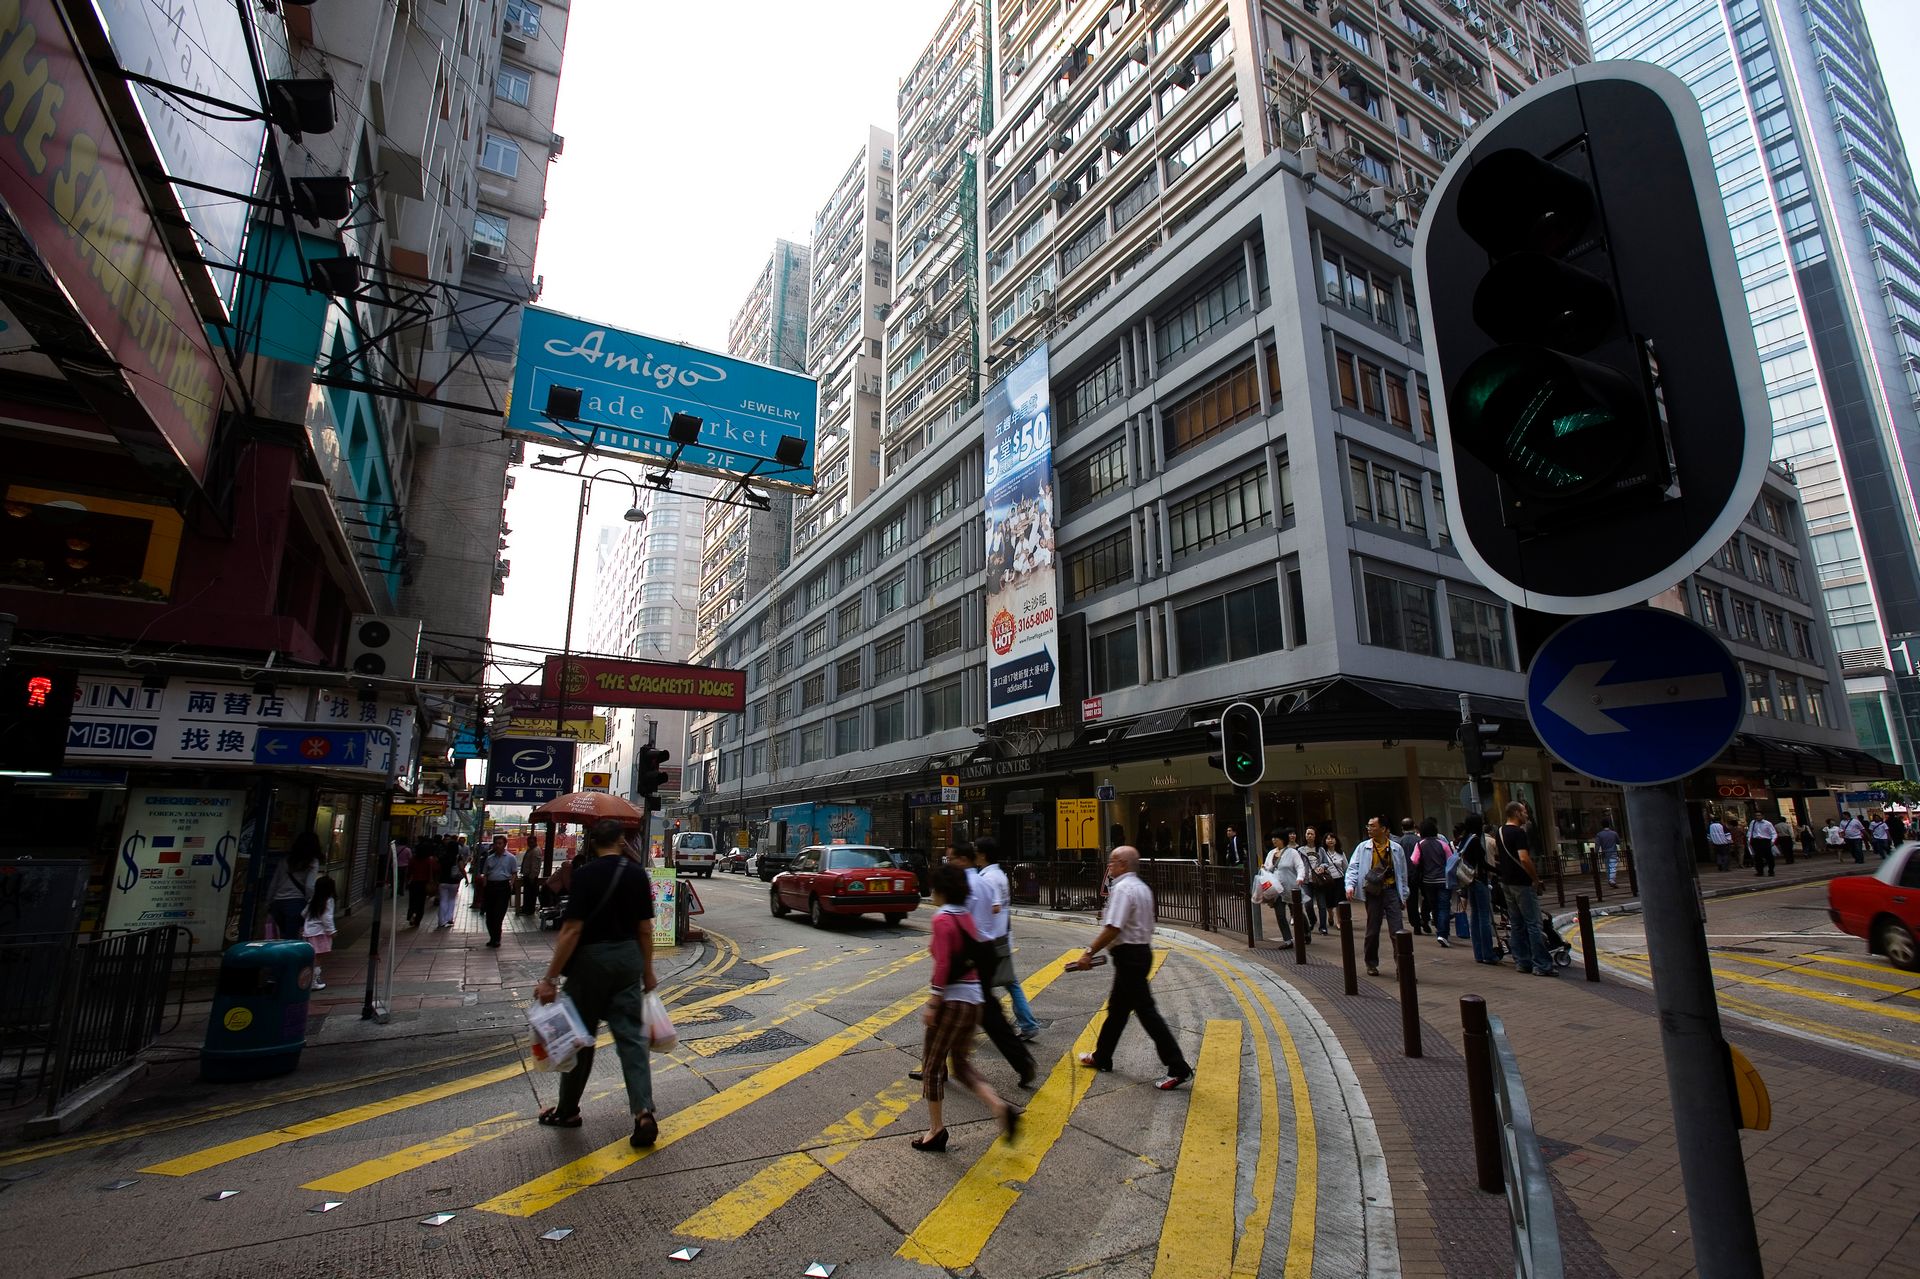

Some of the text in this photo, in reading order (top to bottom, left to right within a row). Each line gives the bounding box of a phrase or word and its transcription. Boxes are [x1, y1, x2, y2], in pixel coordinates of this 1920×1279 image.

[544, 331, 728, 389] Amigo
[588, 394, 645, 421] ade
[740, 399, 801, 421] JEWELRY
[707, 452, 735, 468] 2/F
[1023, 592, 1048, 614] 尖沙咀
[1017, 606, 1054, 633] 3165-8080
[994, 632, 1013, 651] HOT
[595, 672, 626, 690] THE
[698, 679, 735, 699] HOUSE
[188, 689, 285, 718] 兩替店
[329, 694, 405, 729] 找換店
[182, 727, 257, 754] 找換
[496, 771, 564, 788] Fook's Jewelry
[960, 758, 1031, 780] HANKOW CENTRE
